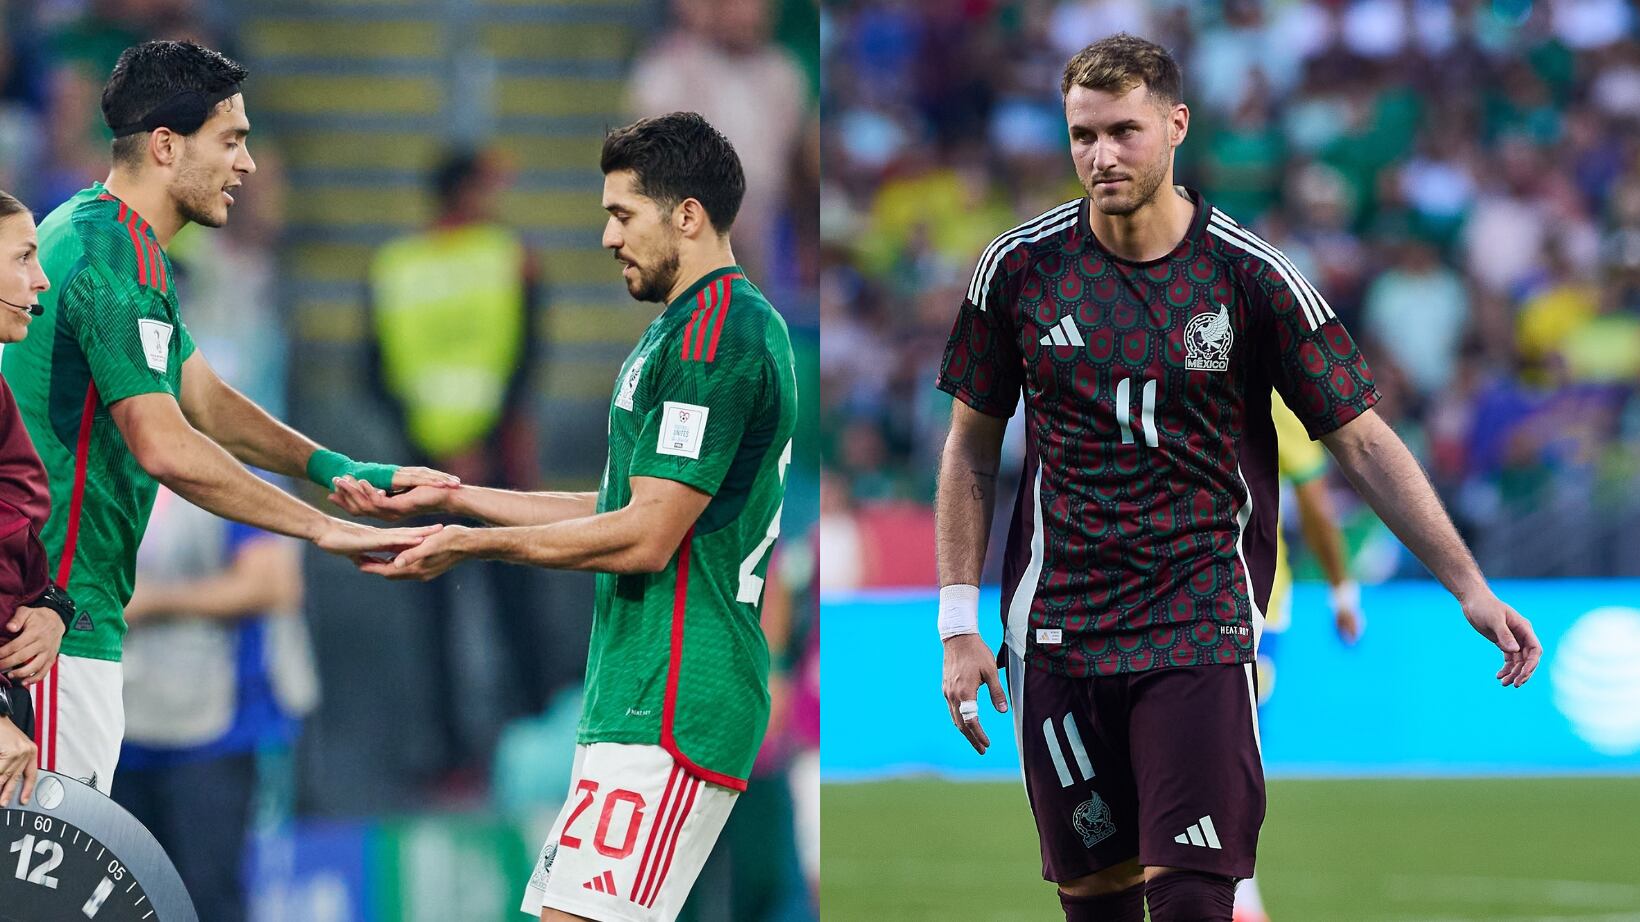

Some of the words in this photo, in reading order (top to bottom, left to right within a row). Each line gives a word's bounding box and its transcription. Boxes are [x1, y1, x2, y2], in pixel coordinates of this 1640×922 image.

[1116, 377, 1159, 447] 11
[1042, 712, 1096, 788] 11
[34, 816, 52, 833] 60
[559, 779, 647, 860] 20
[10, 834, 64, 889] 12
[107, 859, 127, 881] 05
